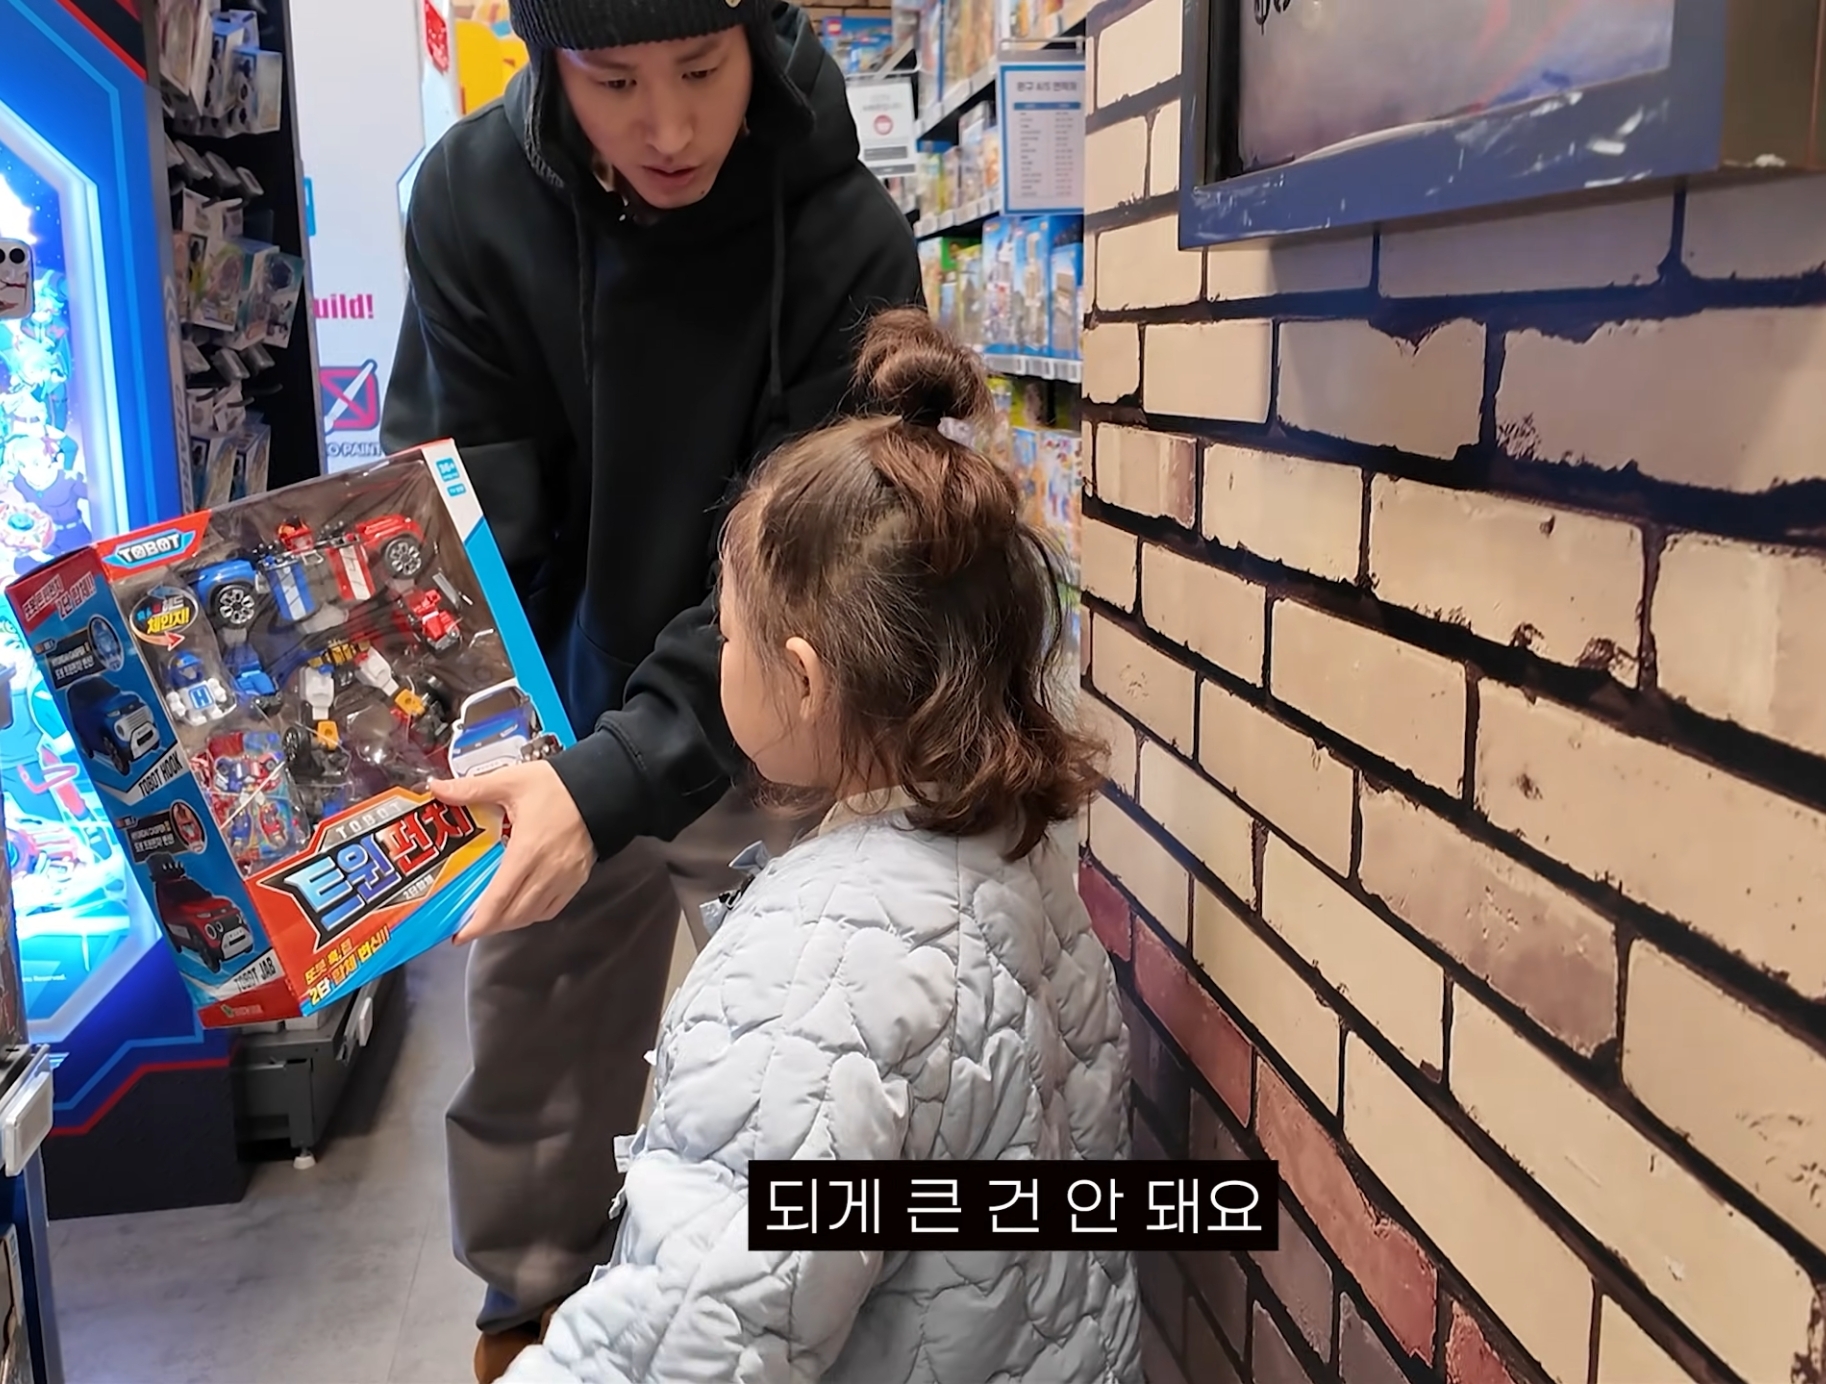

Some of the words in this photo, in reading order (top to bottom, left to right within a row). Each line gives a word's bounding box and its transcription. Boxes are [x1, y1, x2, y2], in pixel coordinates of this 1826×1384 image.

[313, 294, 374, 319] uild!
[118, 533, 180, 562] TOBOT
[191, 689, 210, 708] H
[138, 767, 161, 797] TOBOT
[160, 754, 183, 784] HOOK
[335, 797, 407, 840] TOBOT
[284, 801, 476, 931] 트윈펀치
[258, 957, 277, 981] JAB
[307, 978, 332, 1006] 2단
